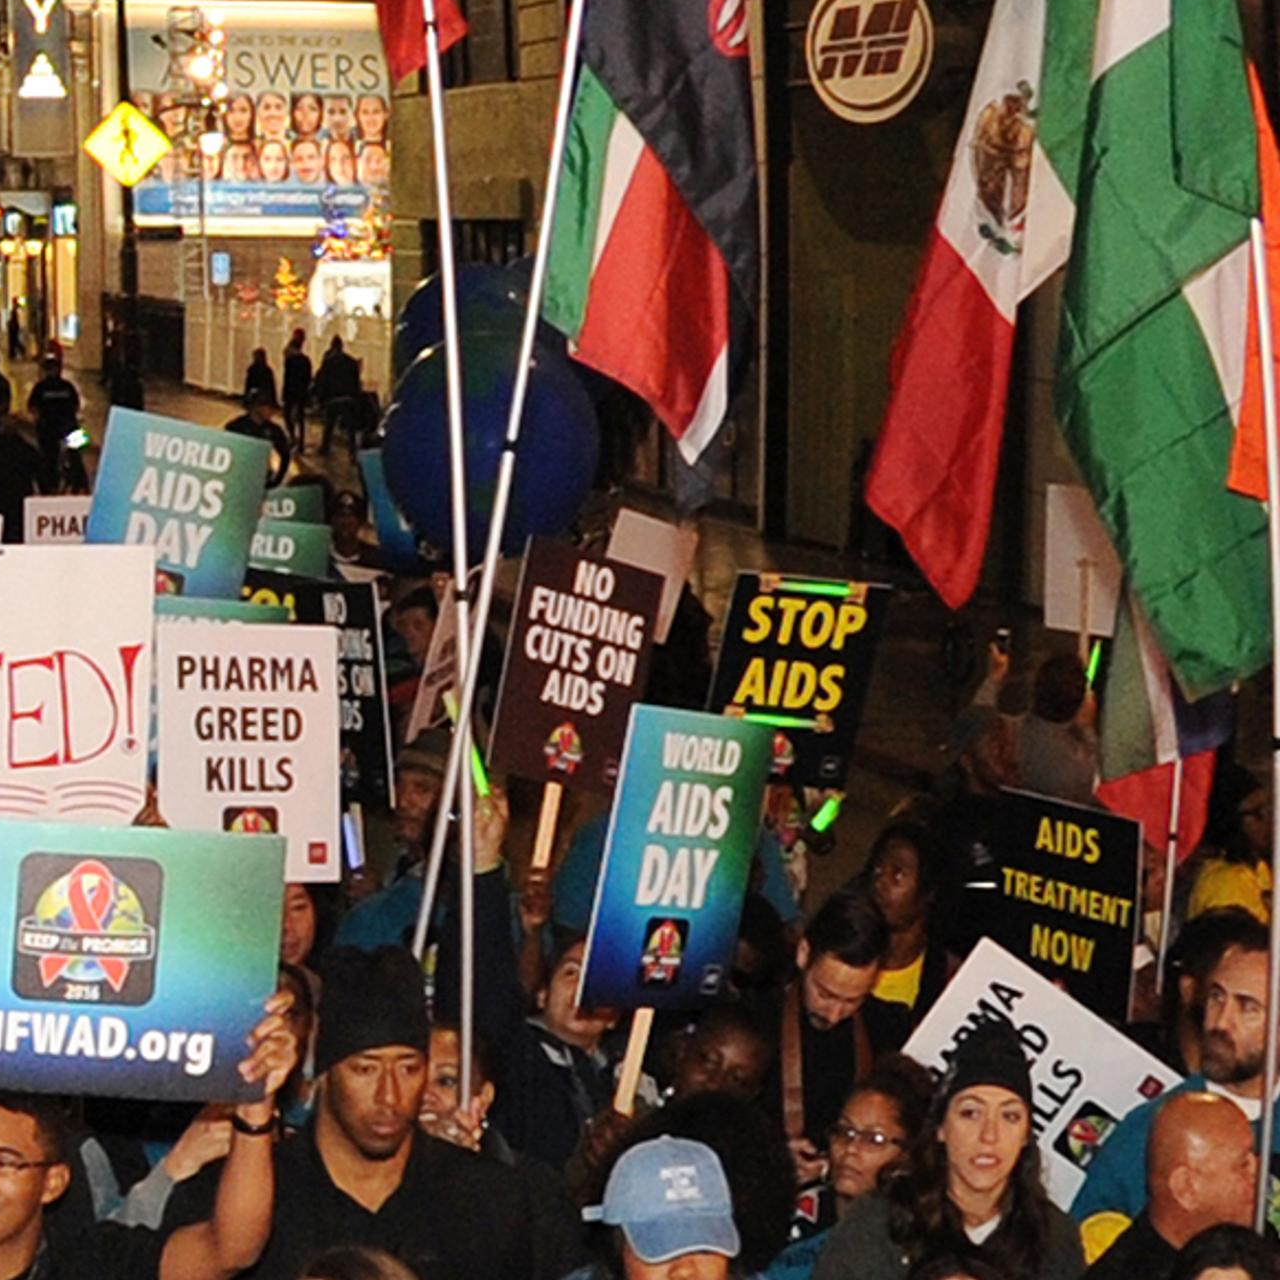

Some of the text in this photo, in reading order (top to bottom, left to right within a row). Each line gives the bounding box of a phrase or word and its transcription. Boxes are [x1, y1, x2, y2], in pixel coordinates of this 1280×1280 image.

[161, 51, 381, 91] ASWERS
[144, 431, 232, 473] WORLD
[131, 469, 226, 519] AIDS
[36, 515, 89, 537] PHA
[123, 511, 214, 568] DAY
[249, 531, 296, 561] RLD
[572, 559, 616, 602] NO
[527, 585, 646, 650] FUNDING
[741, 595, 869, 651] STOP
[177, 655, 319, 693] PHARMA
[524, 625, 638, 687] CUTS ON
[540, 669, 607, 716] AIDS
[732, 656, 847, 712] AIDS
[194, 706, 304, 742] GREED
[339, 699, 365, 732] DS
[205, 756, 295, 793] KILLS
[661, 731, 742, 777] WORLD
[646, 780, 734, 840] AIDS
[1034, 815, 1102, 865] AIDS
[634, 843, 721, 910] DAY
[1000, 866, 1133, 928] TREATMENT
[24, 931, 61, 952] KEEP
[82, 934, 148, 955] PROMISE
[1029, 922, 1096, 973] NOW
[1032, 1058, 1084, 1135] ILLS
